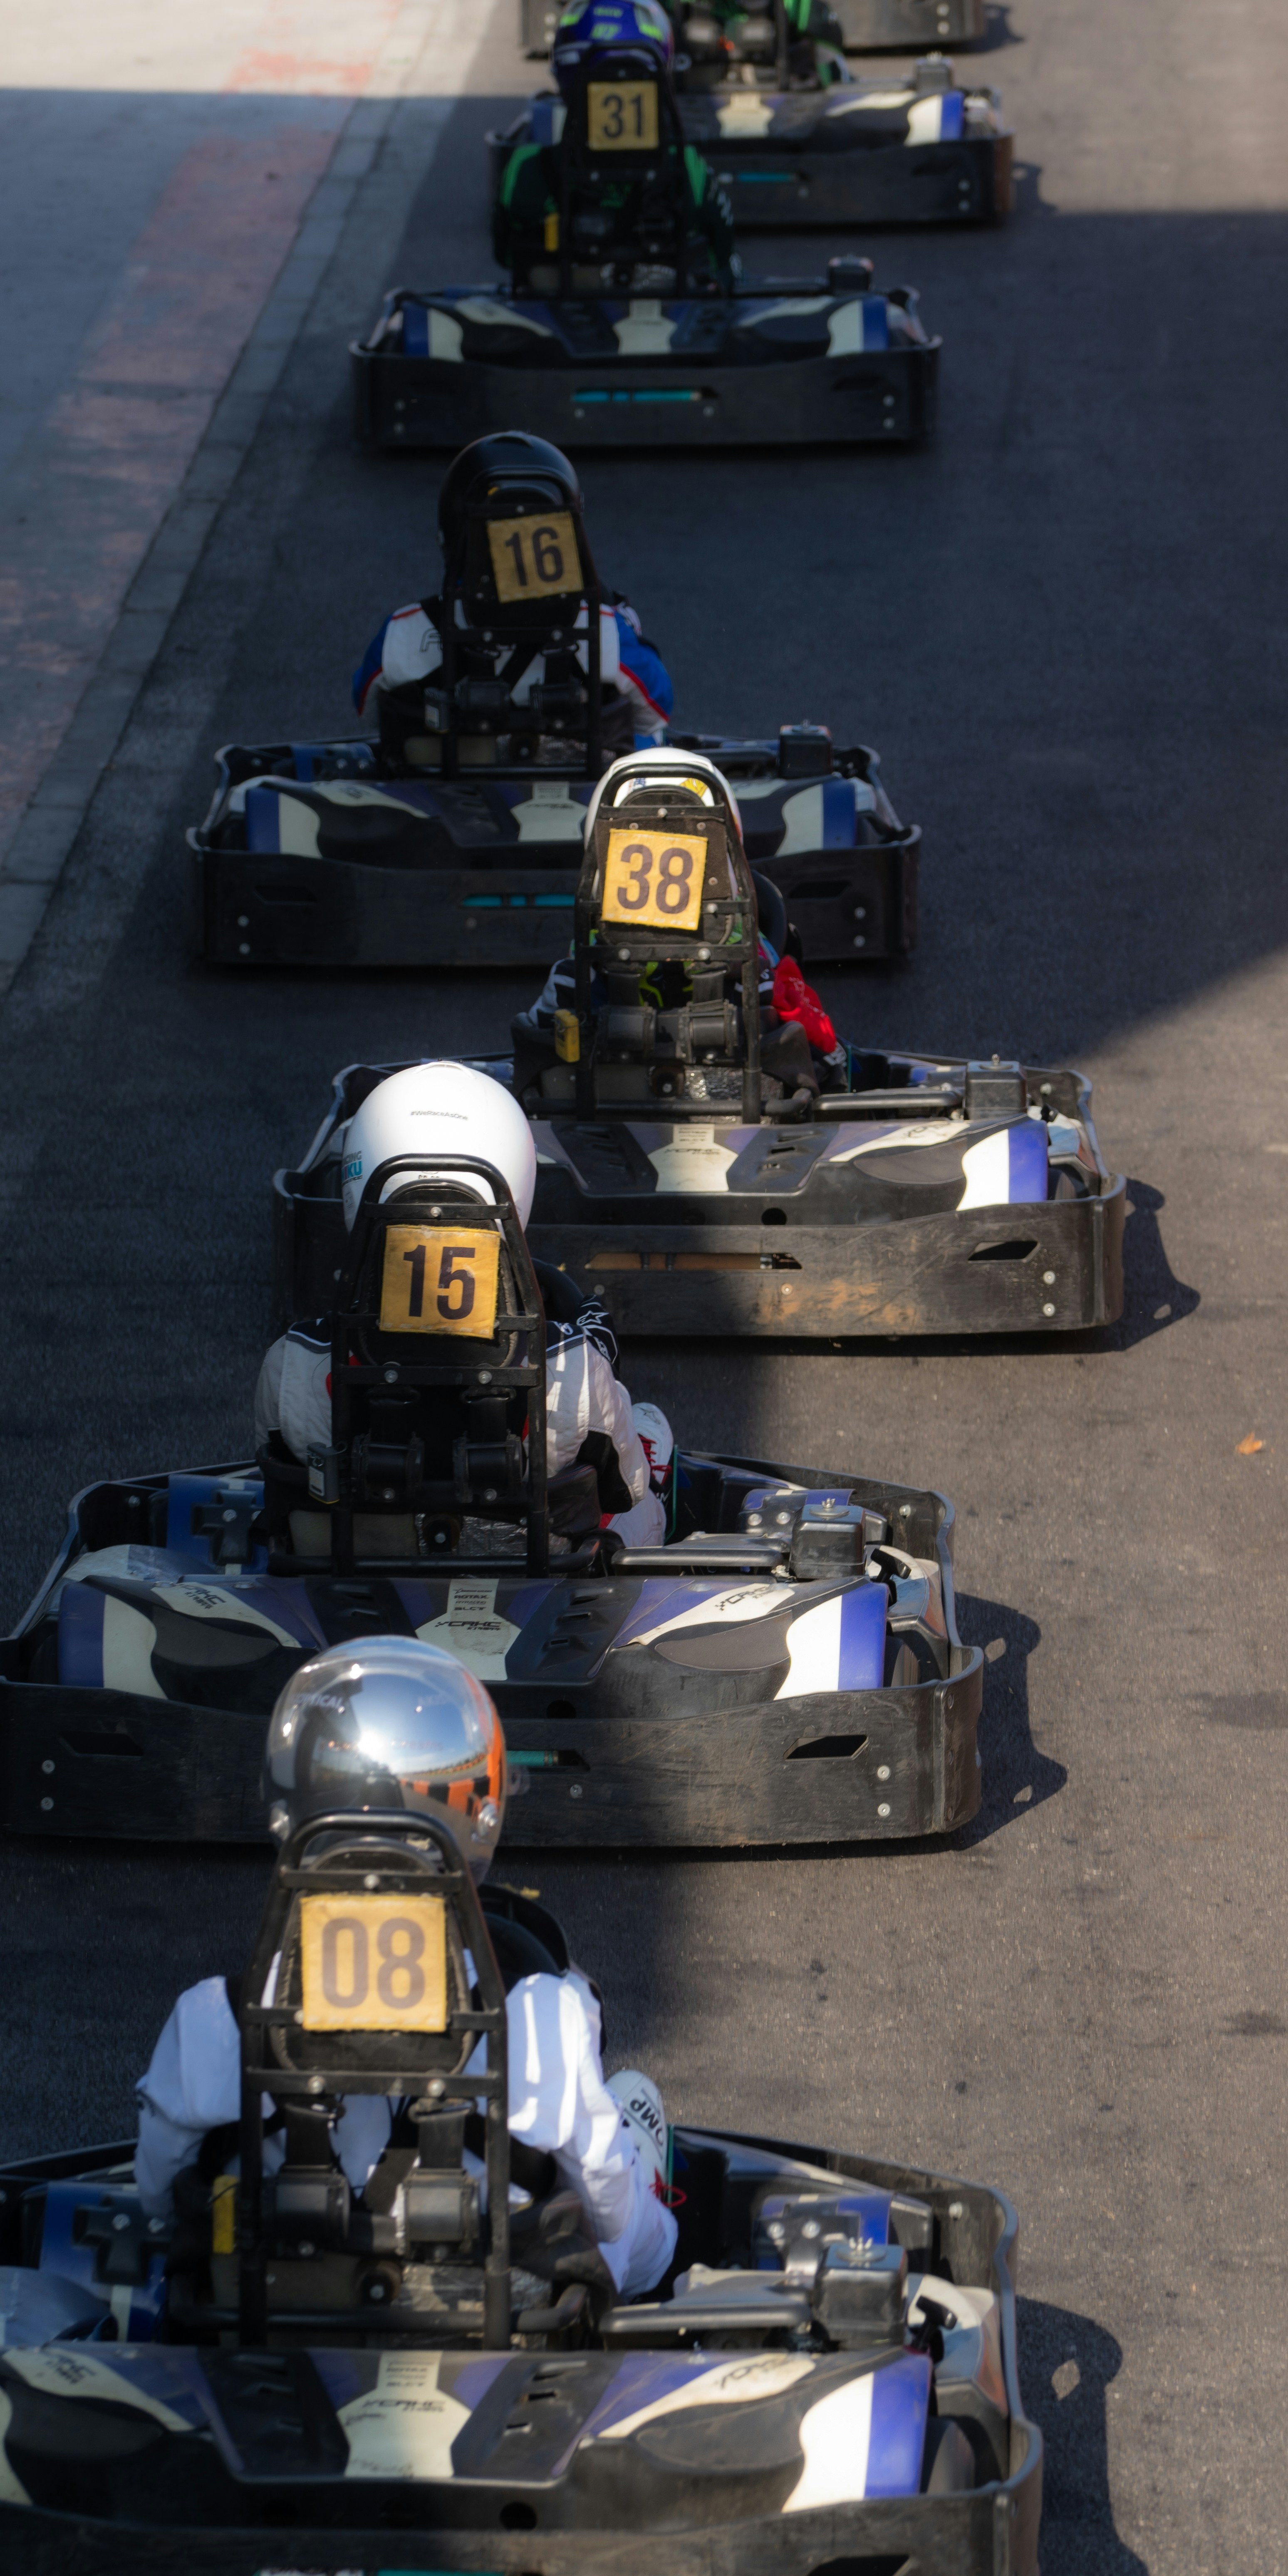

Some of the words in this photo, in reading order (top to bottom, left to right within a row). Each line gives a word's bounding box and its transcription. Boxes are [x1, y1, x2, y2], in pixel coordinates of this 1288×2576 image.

[603, 94, 642, 138] 31
[505, 526, 564, 587] 16
[617, 844, 693, 914] 38
[410, 1110, 468, 1121] #WeRaceAsOne
[403, 1244, 476, 1320] 15
[322, 1917, 426, 2010] 08
